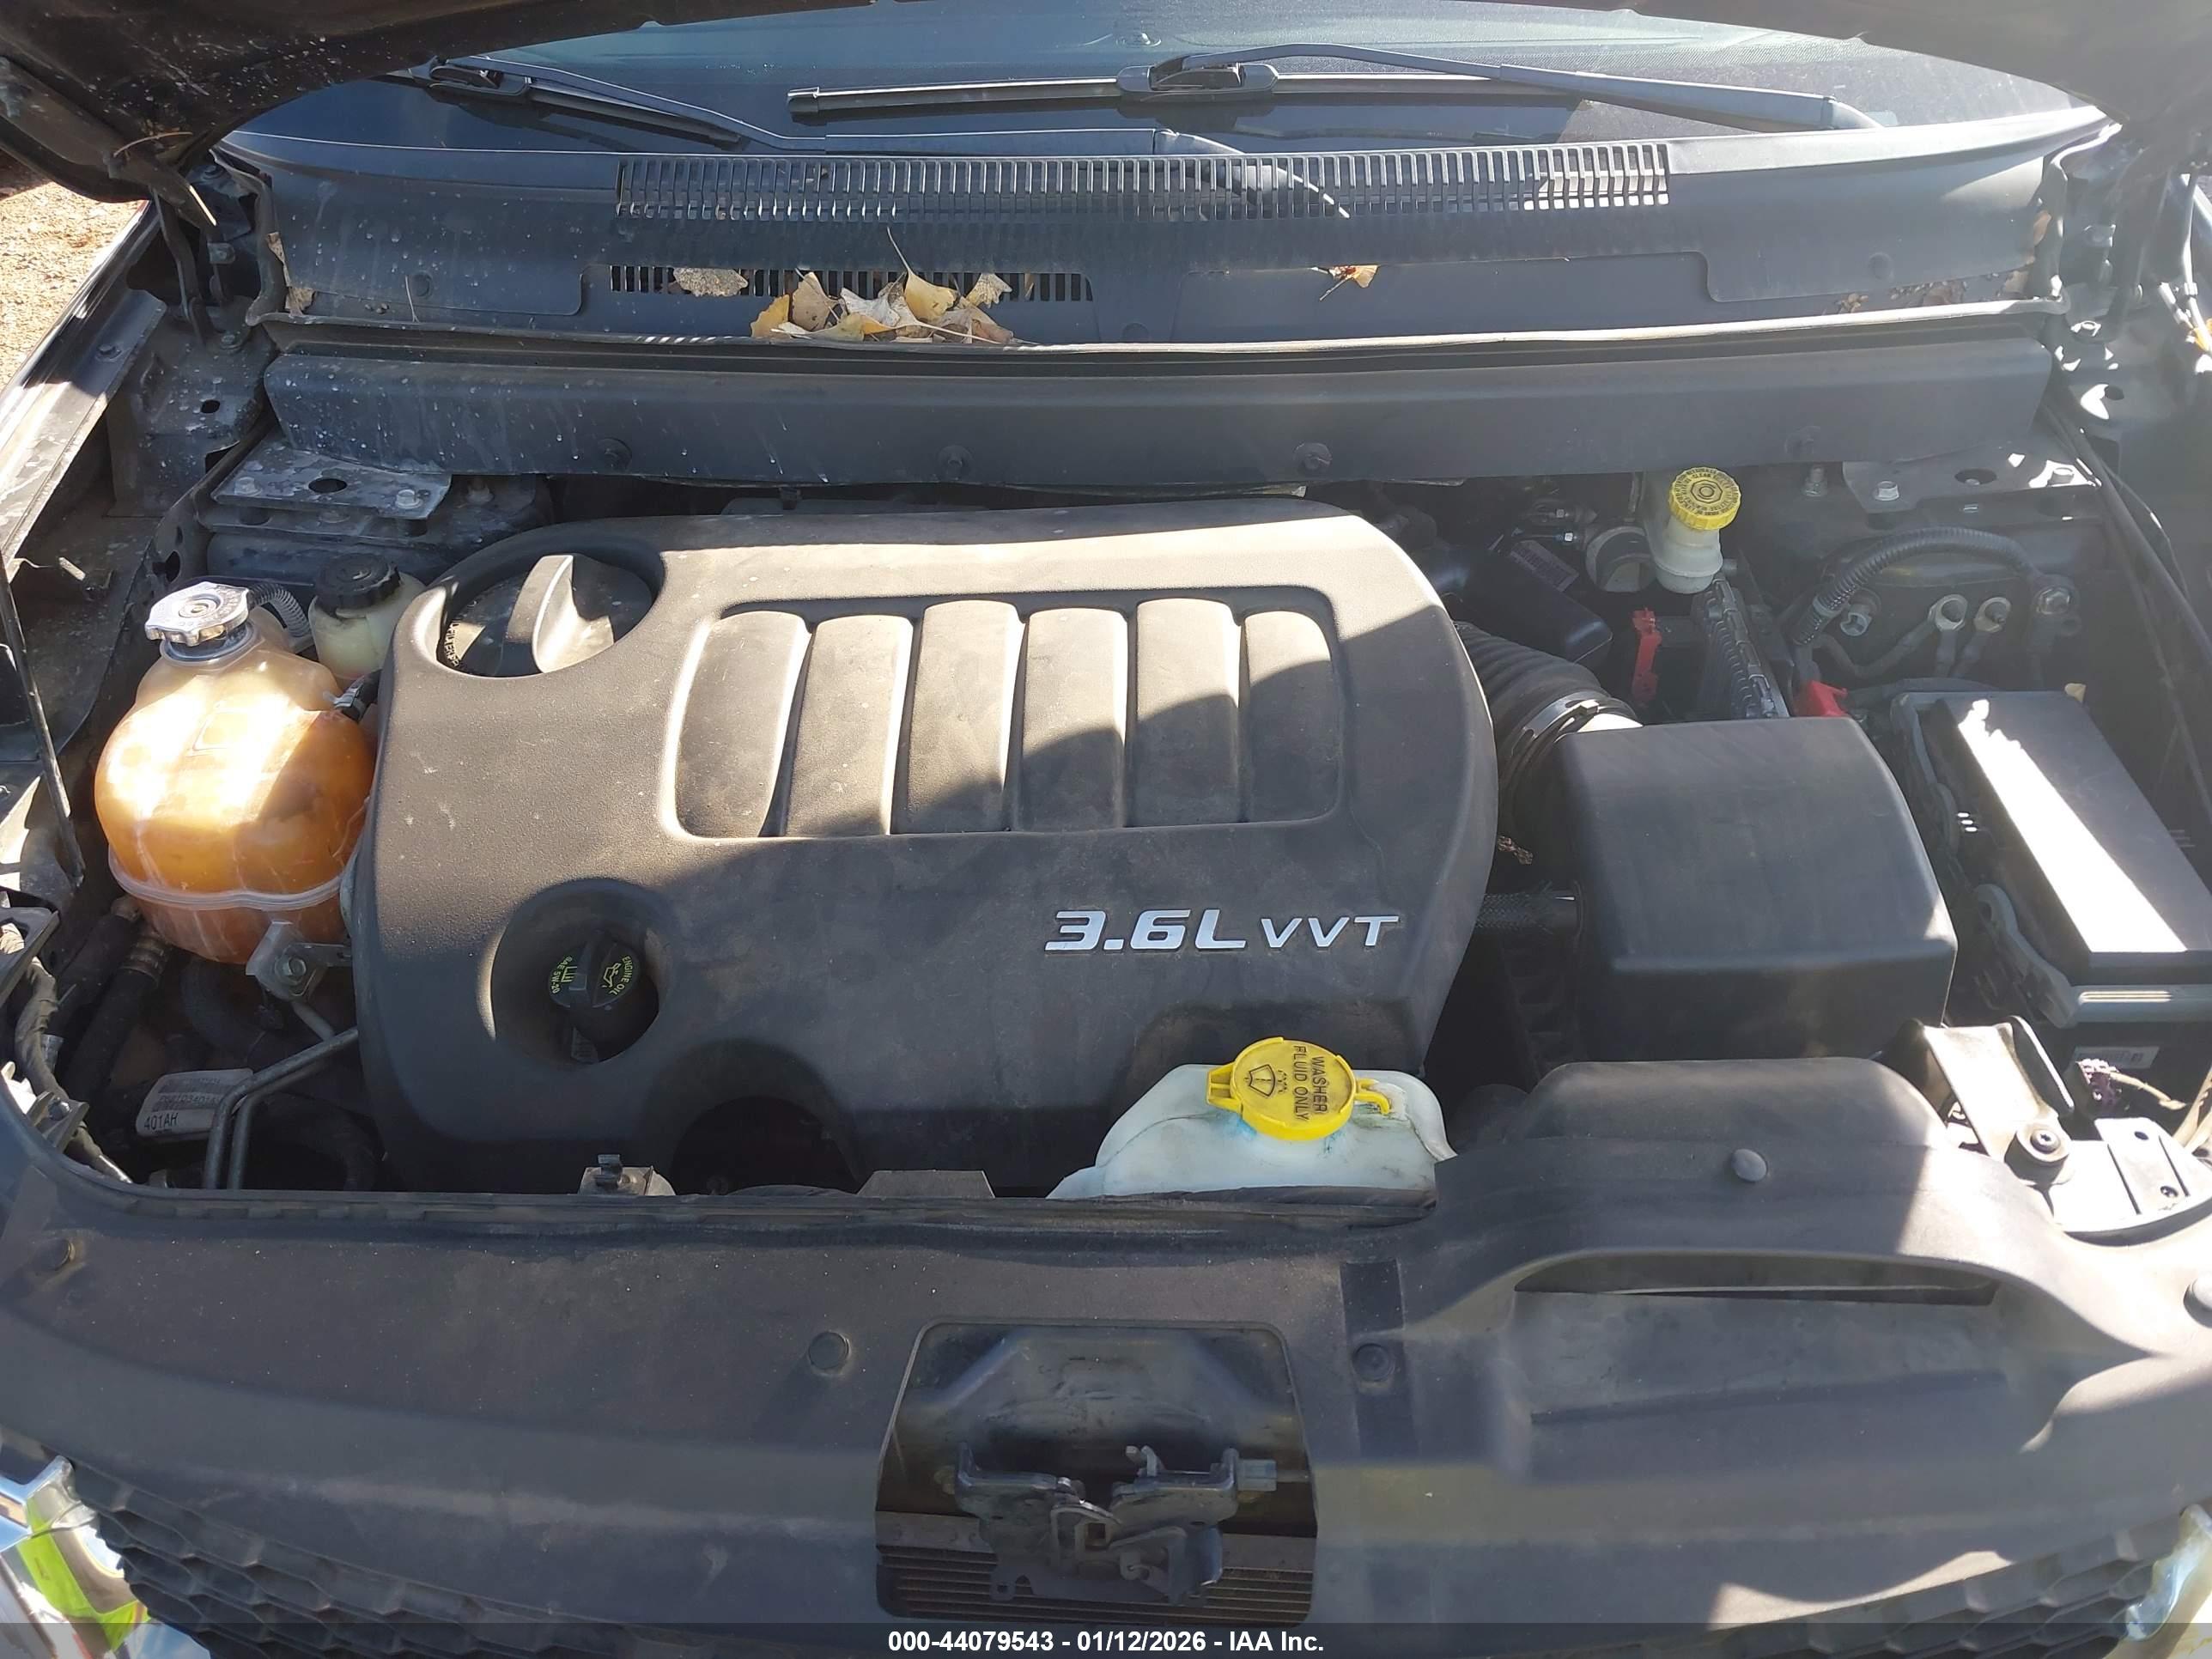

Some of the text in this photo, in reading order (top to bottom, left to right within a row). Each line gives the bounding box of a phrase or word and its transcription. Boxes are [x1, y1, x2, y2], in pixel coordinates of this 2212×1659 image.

[1045, 908, 1400, 951] 3.6L VVT
[550, 970, 562, 994] 5W-20
[609, 955, 633, 995] ENGINE OIL
[1293, 1045, 1310, 1121] FLUID ONLY
[1311, 1055, 1328, 1115] WASHER
[143, 1112, 179, 1131] 401AH
